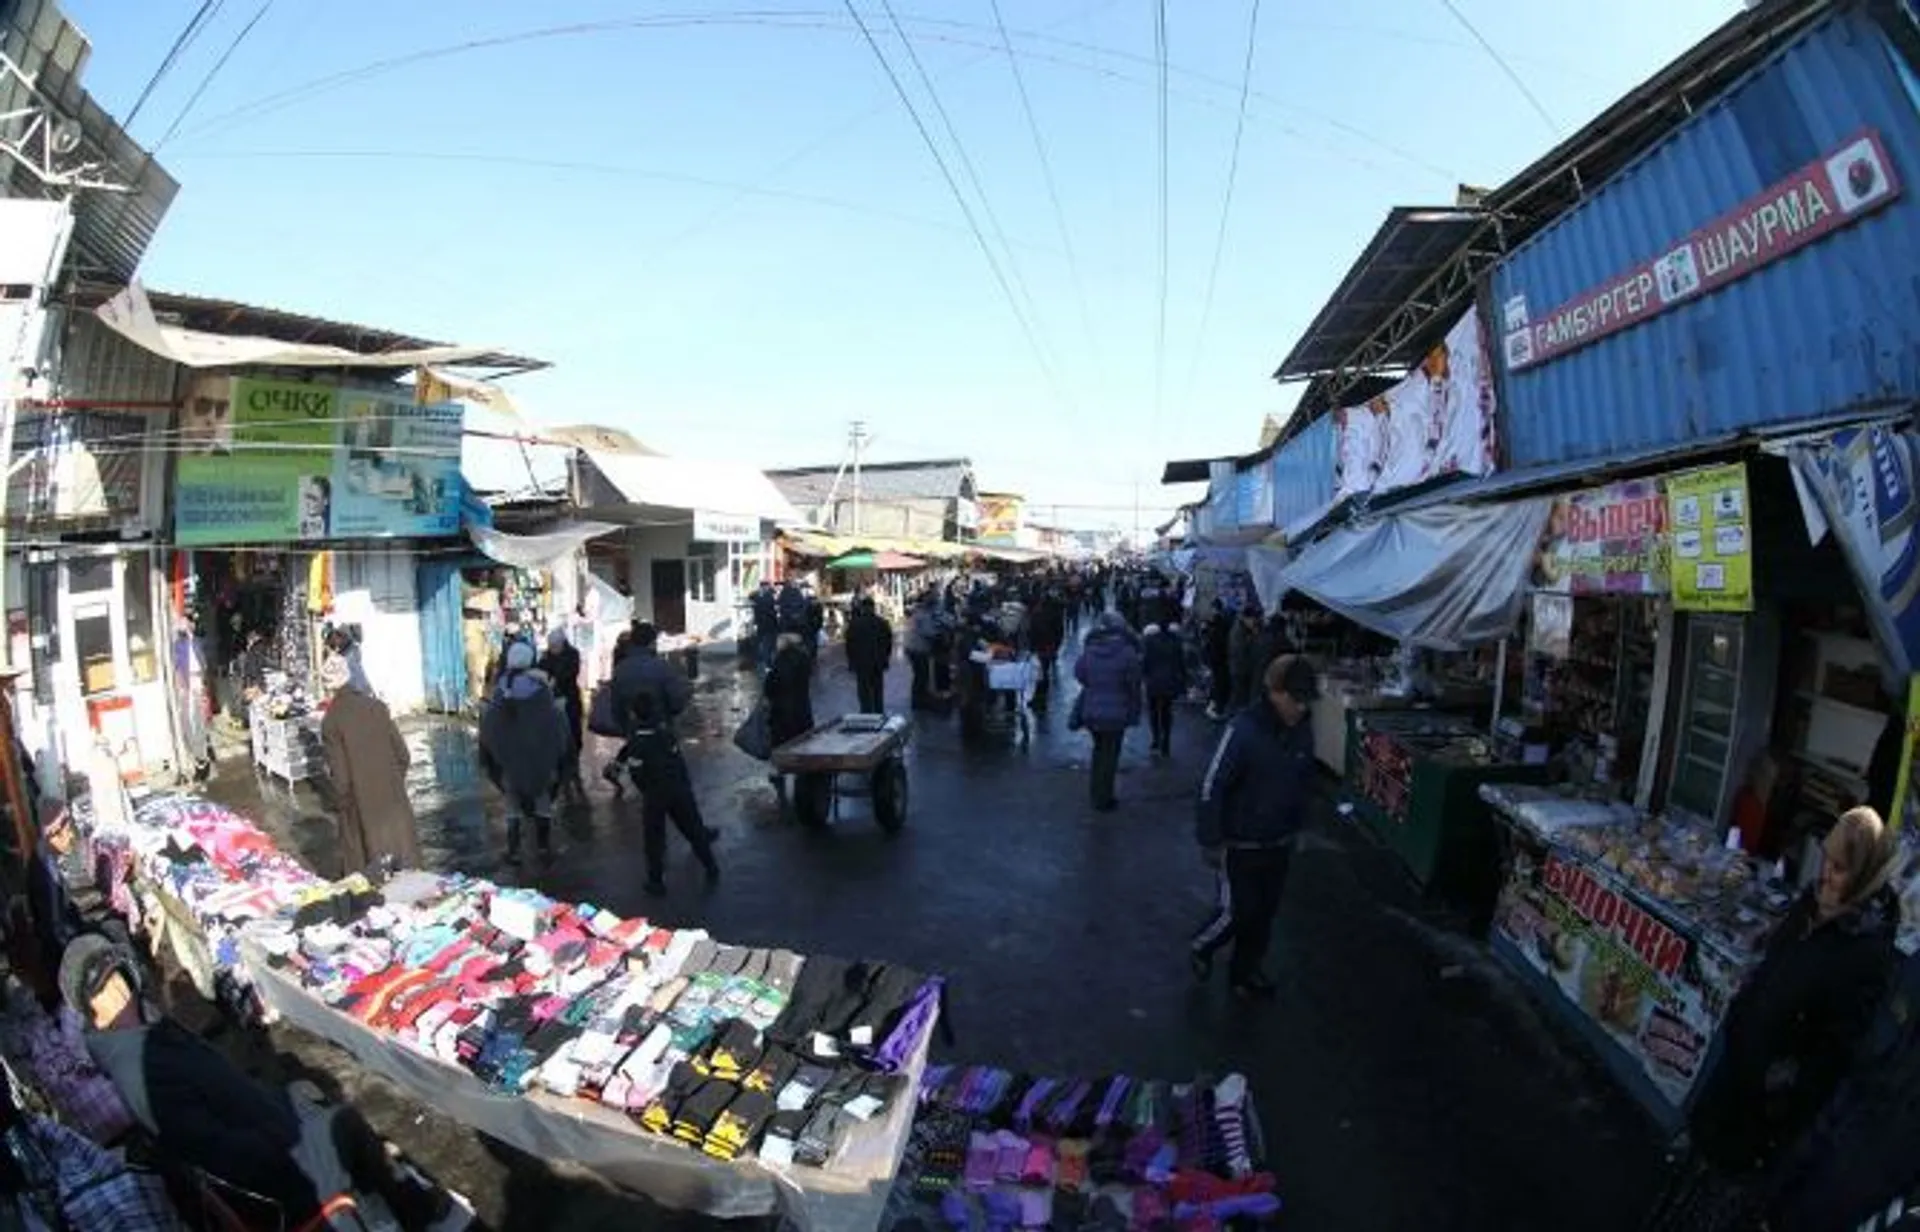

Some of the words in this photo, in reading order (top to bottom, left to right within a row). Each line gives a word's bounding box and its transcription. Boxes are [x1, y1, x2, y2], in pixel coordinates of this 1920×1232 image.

[1535, 272, 1654, 351] ГАМБУРГЕР
[1699, 181, 1832, 277] ШАУРМА
[249, 389, 331, 418] ОЧКИ
